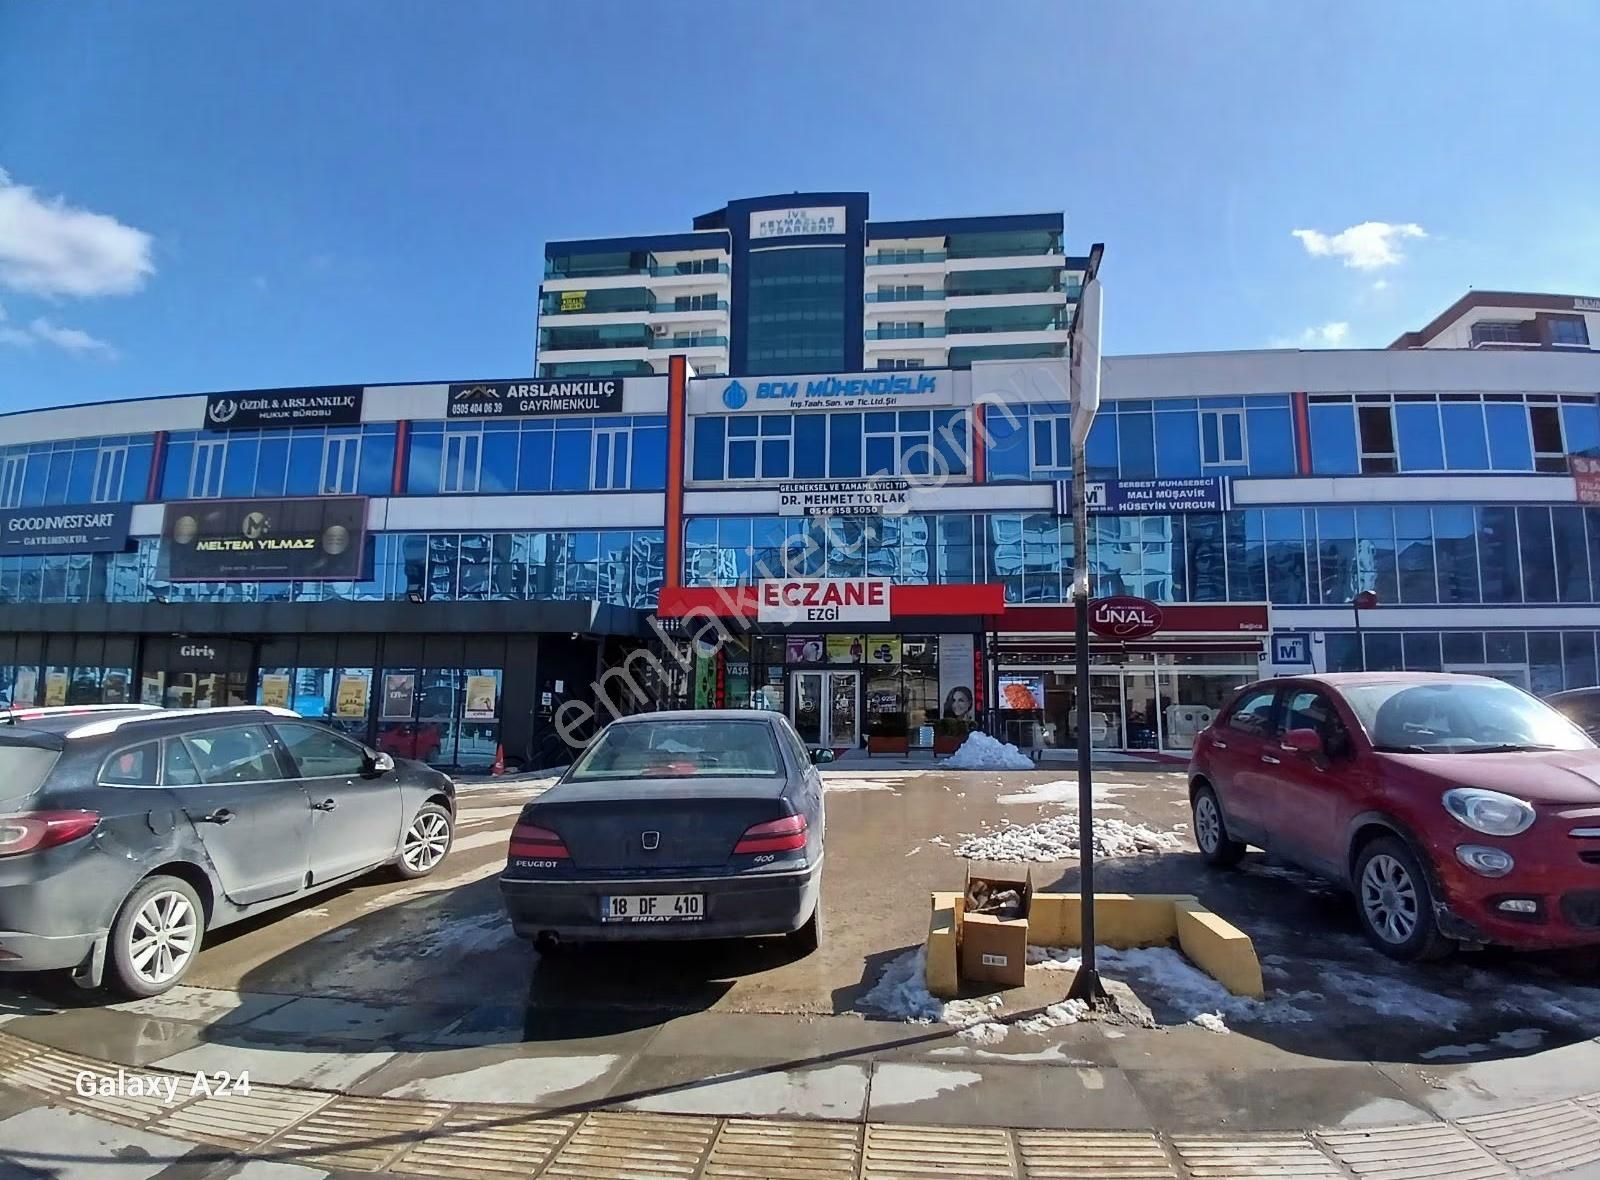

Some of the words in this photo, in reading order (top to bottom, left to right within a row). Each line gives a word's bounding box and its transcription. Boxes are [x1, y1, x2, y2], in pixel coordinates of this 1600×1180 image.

[506, 382, 615, 398] ARSLANKILIÇ
[755, 383, 798, 399] BCM
[805, 375, 936, 397] MÜHENDİSLİK
[272, 400, 279, 408] &
[280, 396, 355, 408] ARSLANKILIÇ
[519, 398, 600, 412] GAYRİMENKUL
[452, 404, 469, 414] 0505
[470, 404, 483, 413] 404
[493, 403, 502, 412] 39
[780, 484, 828, 492] GELENEKSEL
[830, 483, 839, 491] VE
[781, 495, 801, 505] DR.
[804, 494, 854, 504] MEHMET
[858, 493, 905, 503] TORLAK
[1127, 489, 1153, 499] MALİ
[1156, 488, 1205, 500] MÜŞAVİR
[853, 506, 878, 514] 5050
[1119, 501, 1166, 511] HÜSEYİN
[1169, 500, 1216, 510] VURGUN
[197, 540, 254, 551] MELTEM
[258, 539, 315, 550] YILMAZ
[764, 582, 884, 607] ECZANE
[807, 607, 839, 621] EZGİ
[180, 645, 215, 660] Giriş
[516, 860, 557, 868] PEUGEOT
[612, 898, 627, 915] 18
[639, 897, 657, 914] DF
[674, 896, 698, 914] 410
